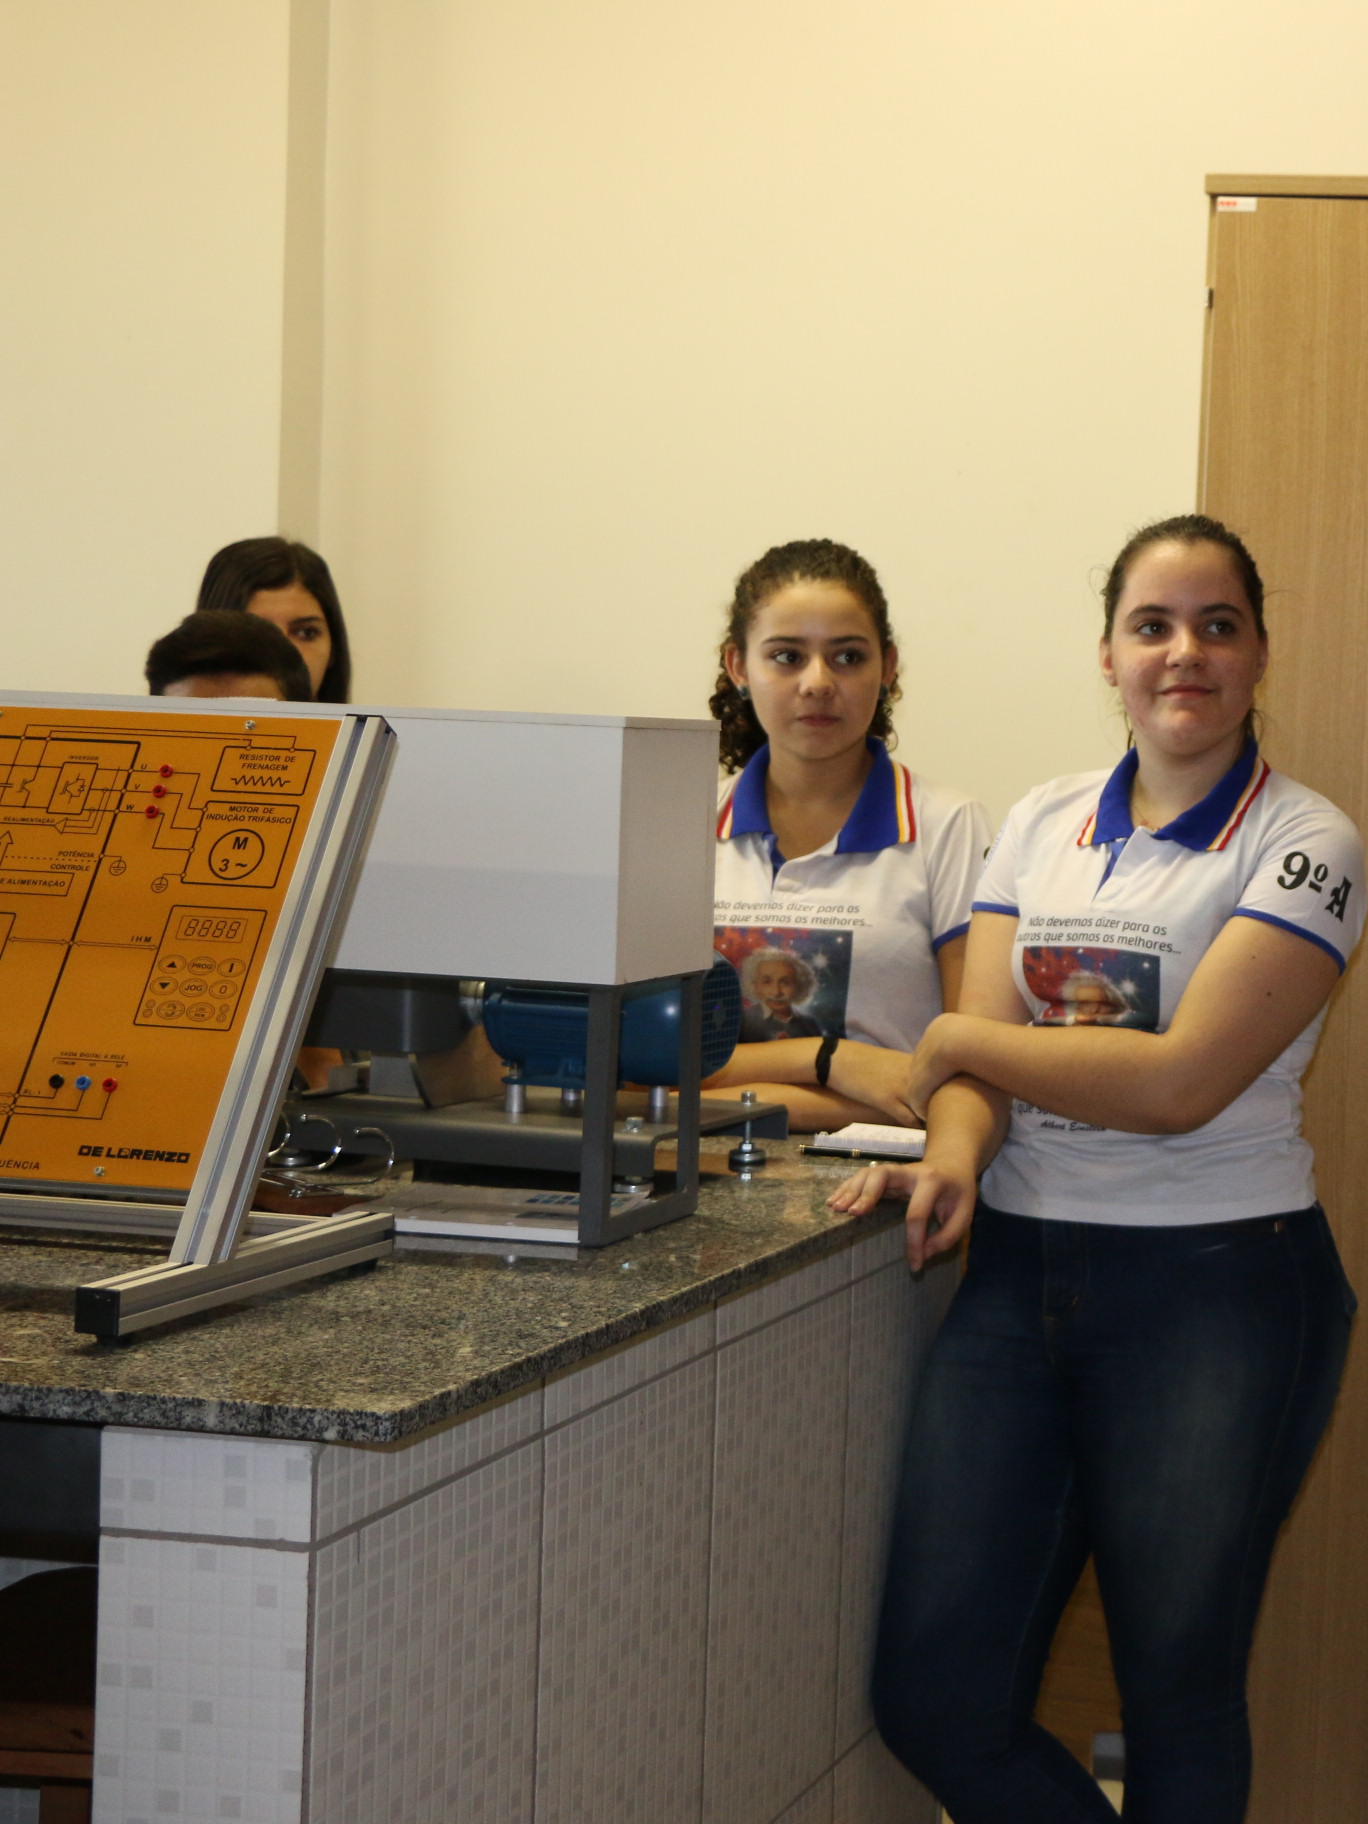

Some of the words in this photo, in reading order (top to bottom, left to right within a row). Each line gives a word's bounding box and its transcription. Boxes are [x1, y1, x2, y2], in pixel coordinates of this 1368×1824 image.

[240, 753, 281, 762] RESISTOR
[241, 762, 288, 771] FRENAGEM
[228, 805, 259, 813] MOTOR
[232, 836, 249, 850] M
[50, 863, 91, 872] CONTROLE
[218, 858, 230, 872] 3
[733, 901, 783, 910] devemos
[786, 902, 813, 912] dizer
[817, 904, 844, 914] para
[847, 905, 860, 913] os
[729, 914, 750, 923] que
[755, 914, 791, 923] somos
[795, 916, 807, 924] os
[1046, 917, 1093, 928] devemos
[1095, 918, 1120, 929] dizer
[1121, 920, 1149, 933] para
[1152, 925, 1167, 936] os
[1043, 933, 1063, 943] que
[1066, 933, 1100, 942] somos
[1102, 934, 1115, 943] os
[184, 984, 203, 992] JOG
[78, 1145, 104, 1157] DE
[105, 1147, 190, 1164] LORENZO
